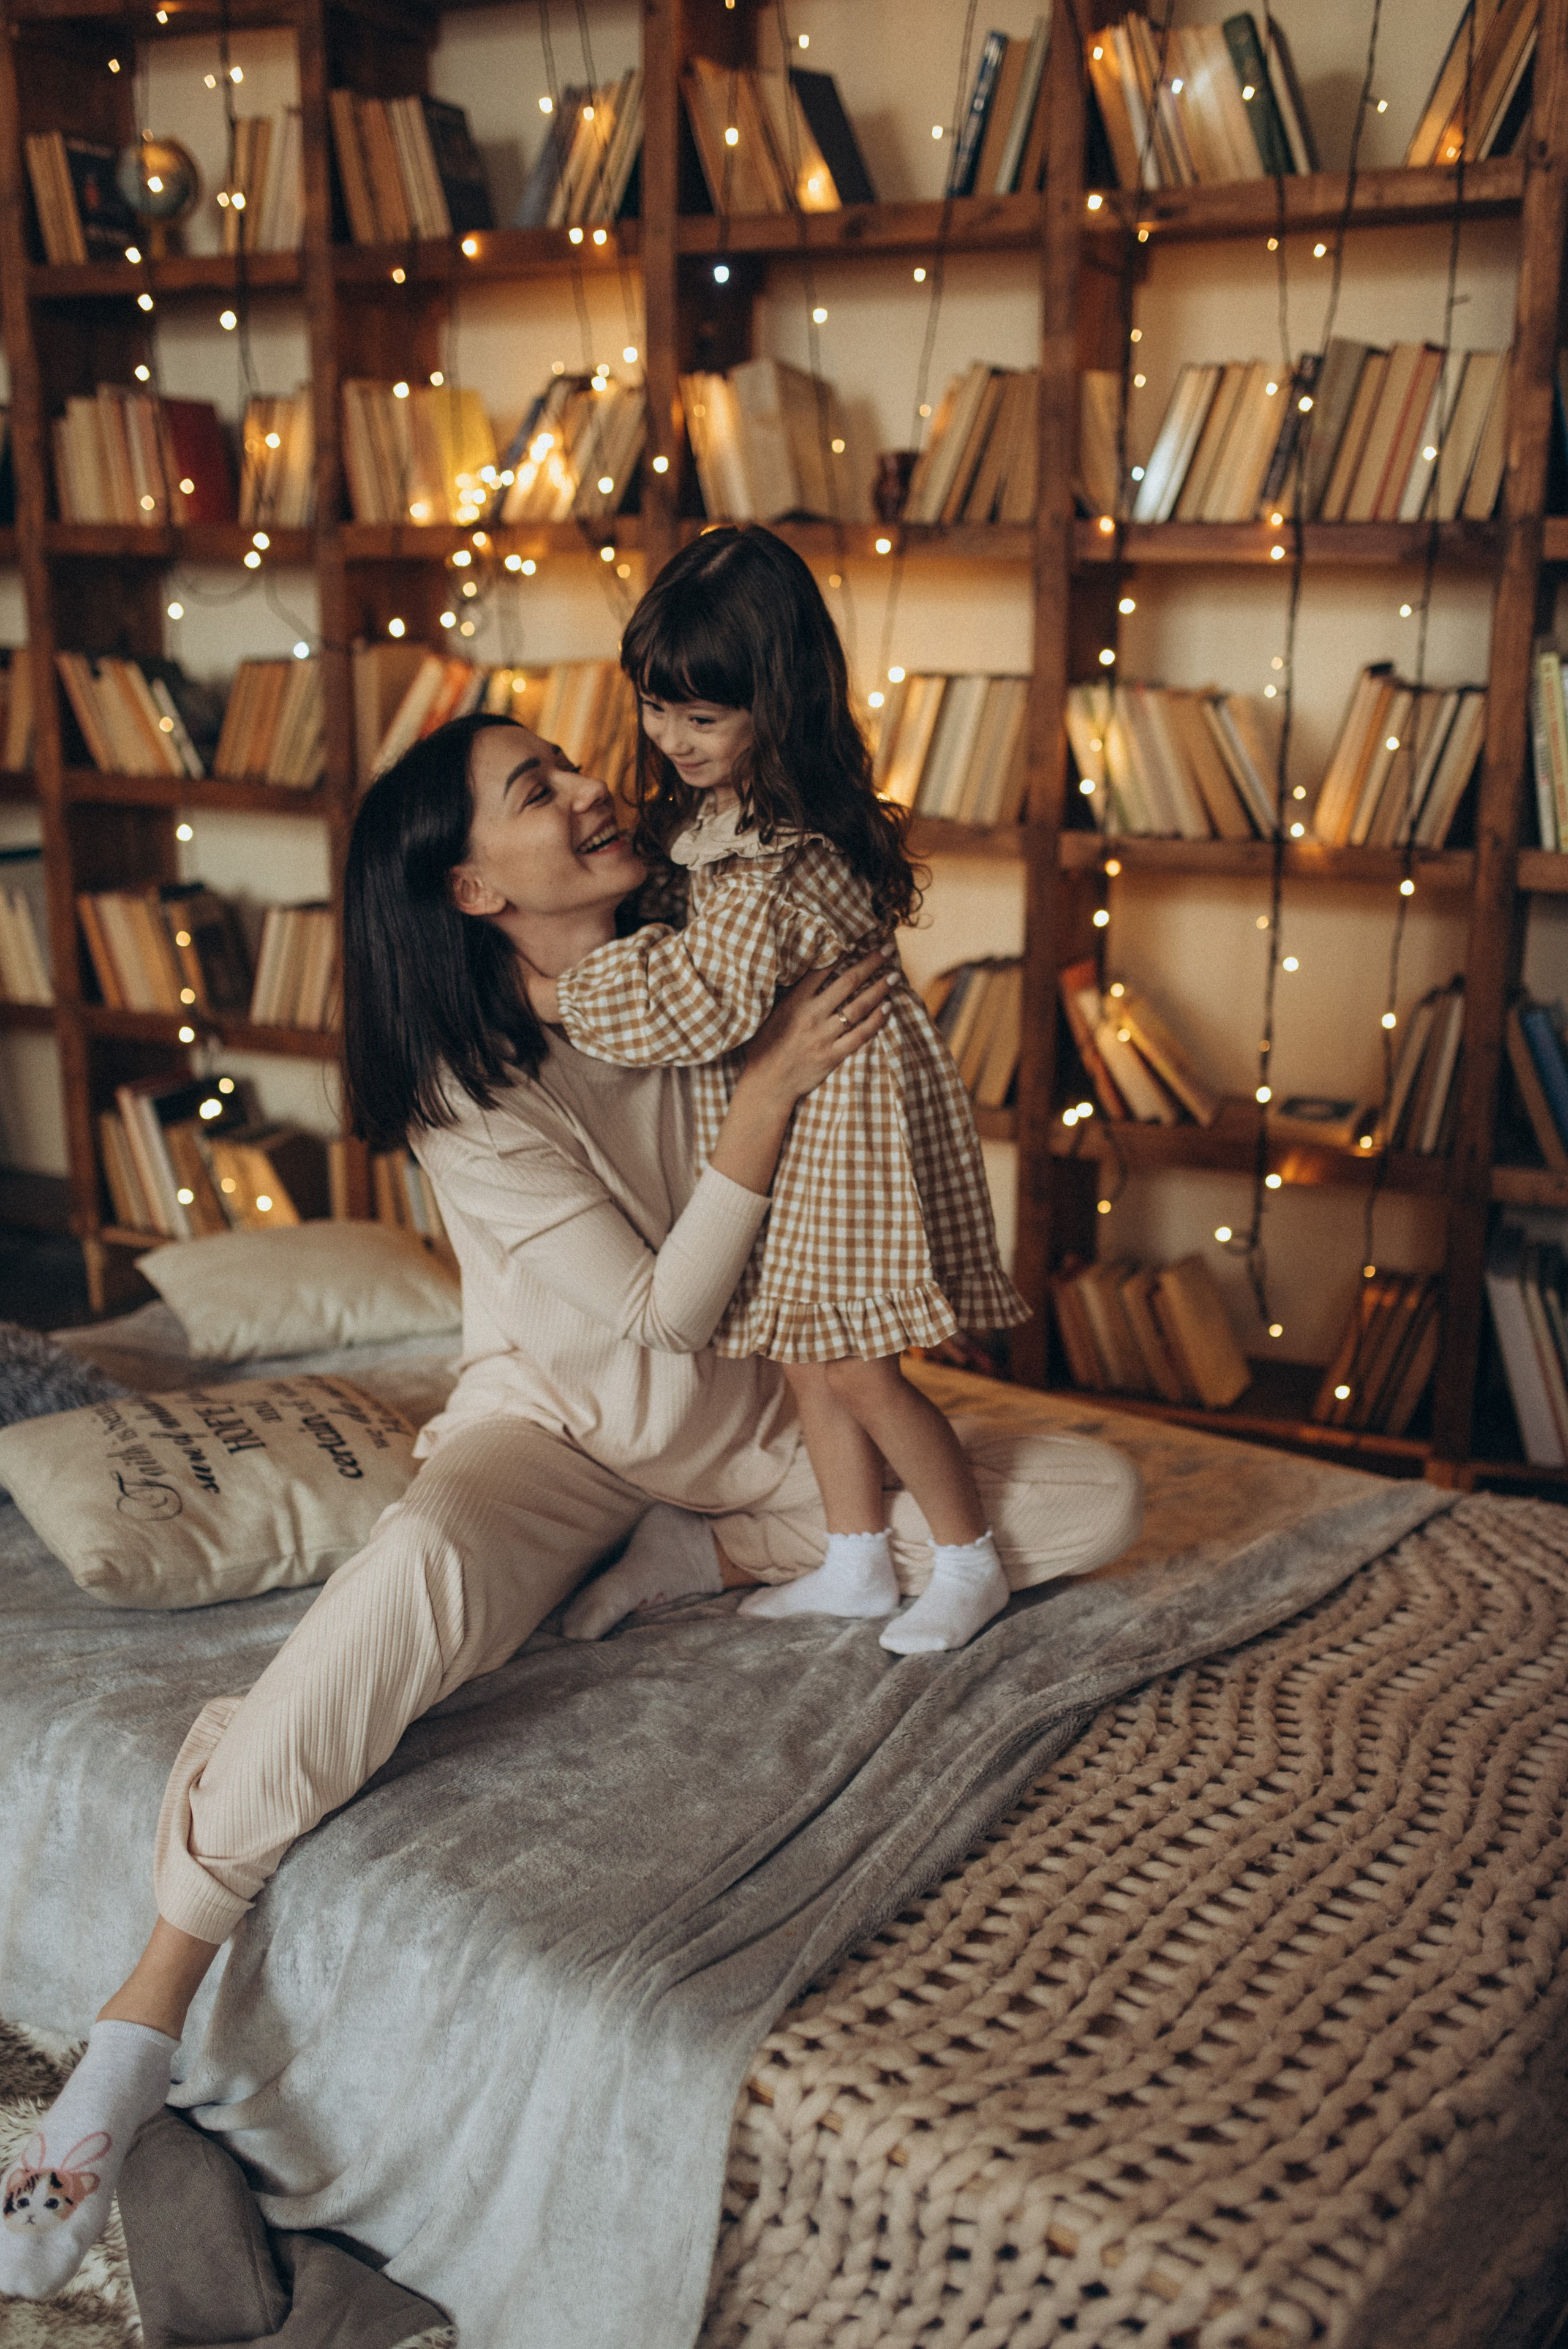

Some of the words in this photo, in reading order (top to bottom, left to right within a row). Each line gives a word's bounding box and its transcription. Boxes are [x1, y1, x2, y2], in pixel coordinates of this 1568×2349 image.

[149, 1433, 207, 1446] of
[194, 1406, 266, 1455] HOPE
[298, 1414, 364, 1480] certain
[107, 1443, 183, 1521] Faith
[182, 1448, 221, 1495] sure
